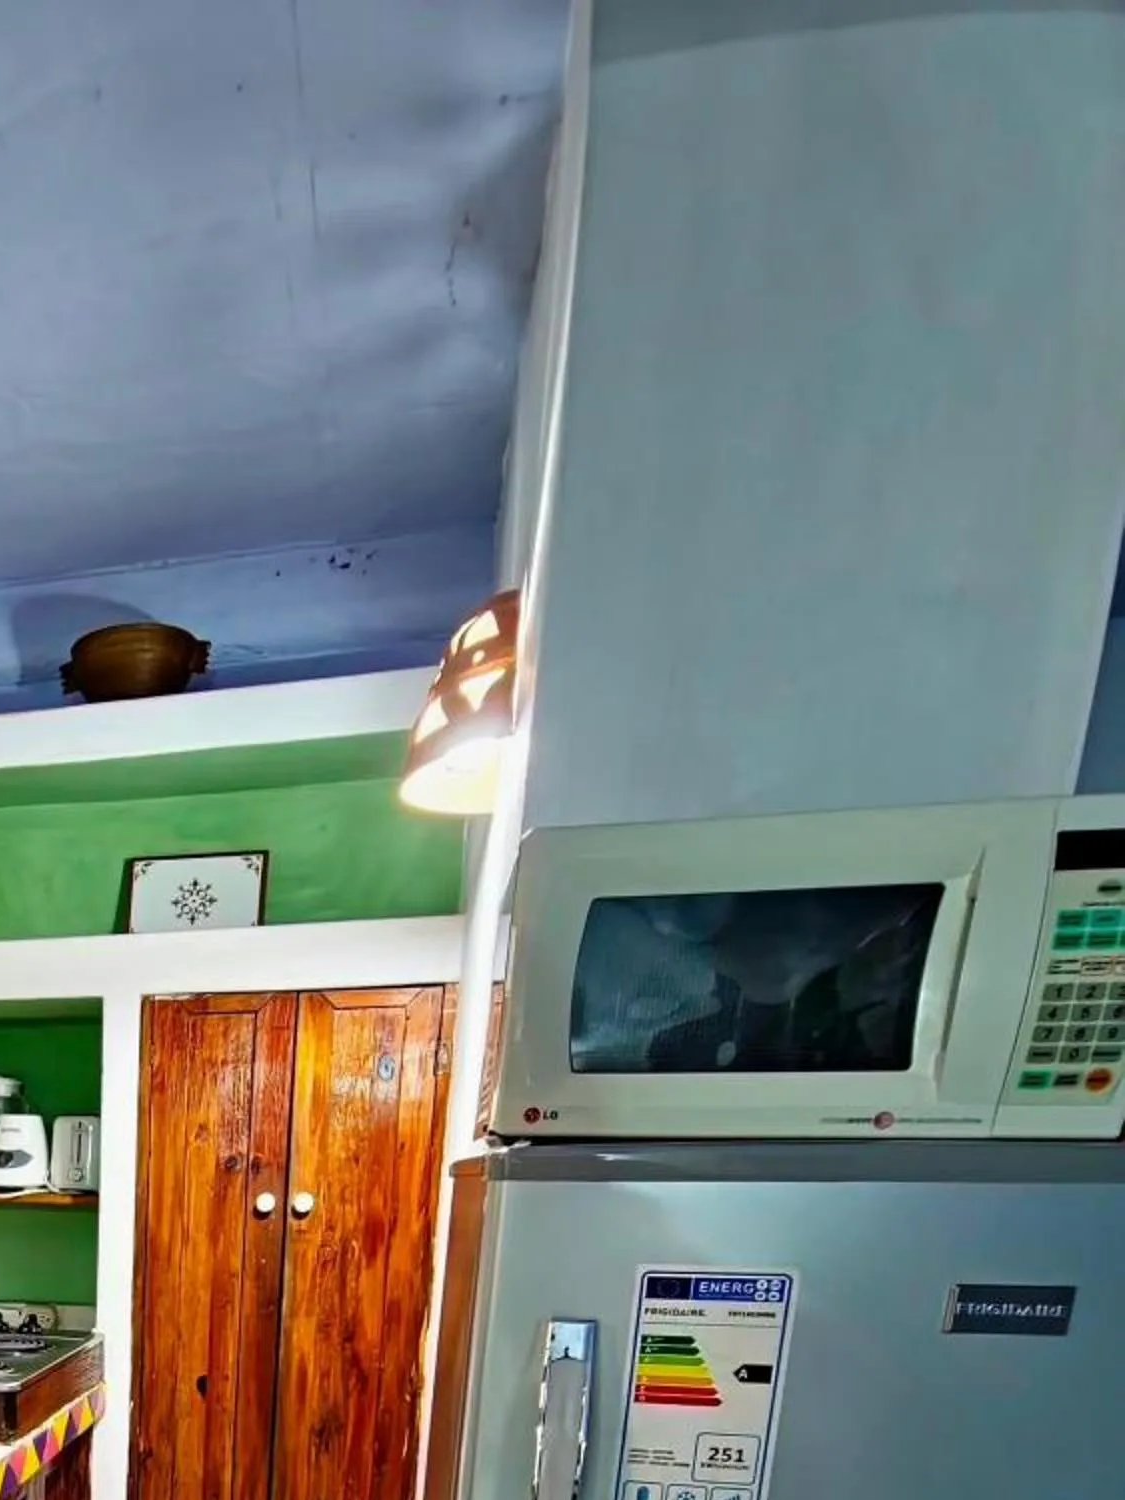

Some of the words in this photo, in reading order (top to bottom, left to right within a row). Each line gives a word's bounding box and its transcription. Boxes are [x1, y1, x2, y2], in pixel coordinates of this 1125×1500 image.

[542, 1109, 559, 1121] LG
[698, 1281, 755, 1295] ENERG
[708, 1447, 746, 1463] 251
